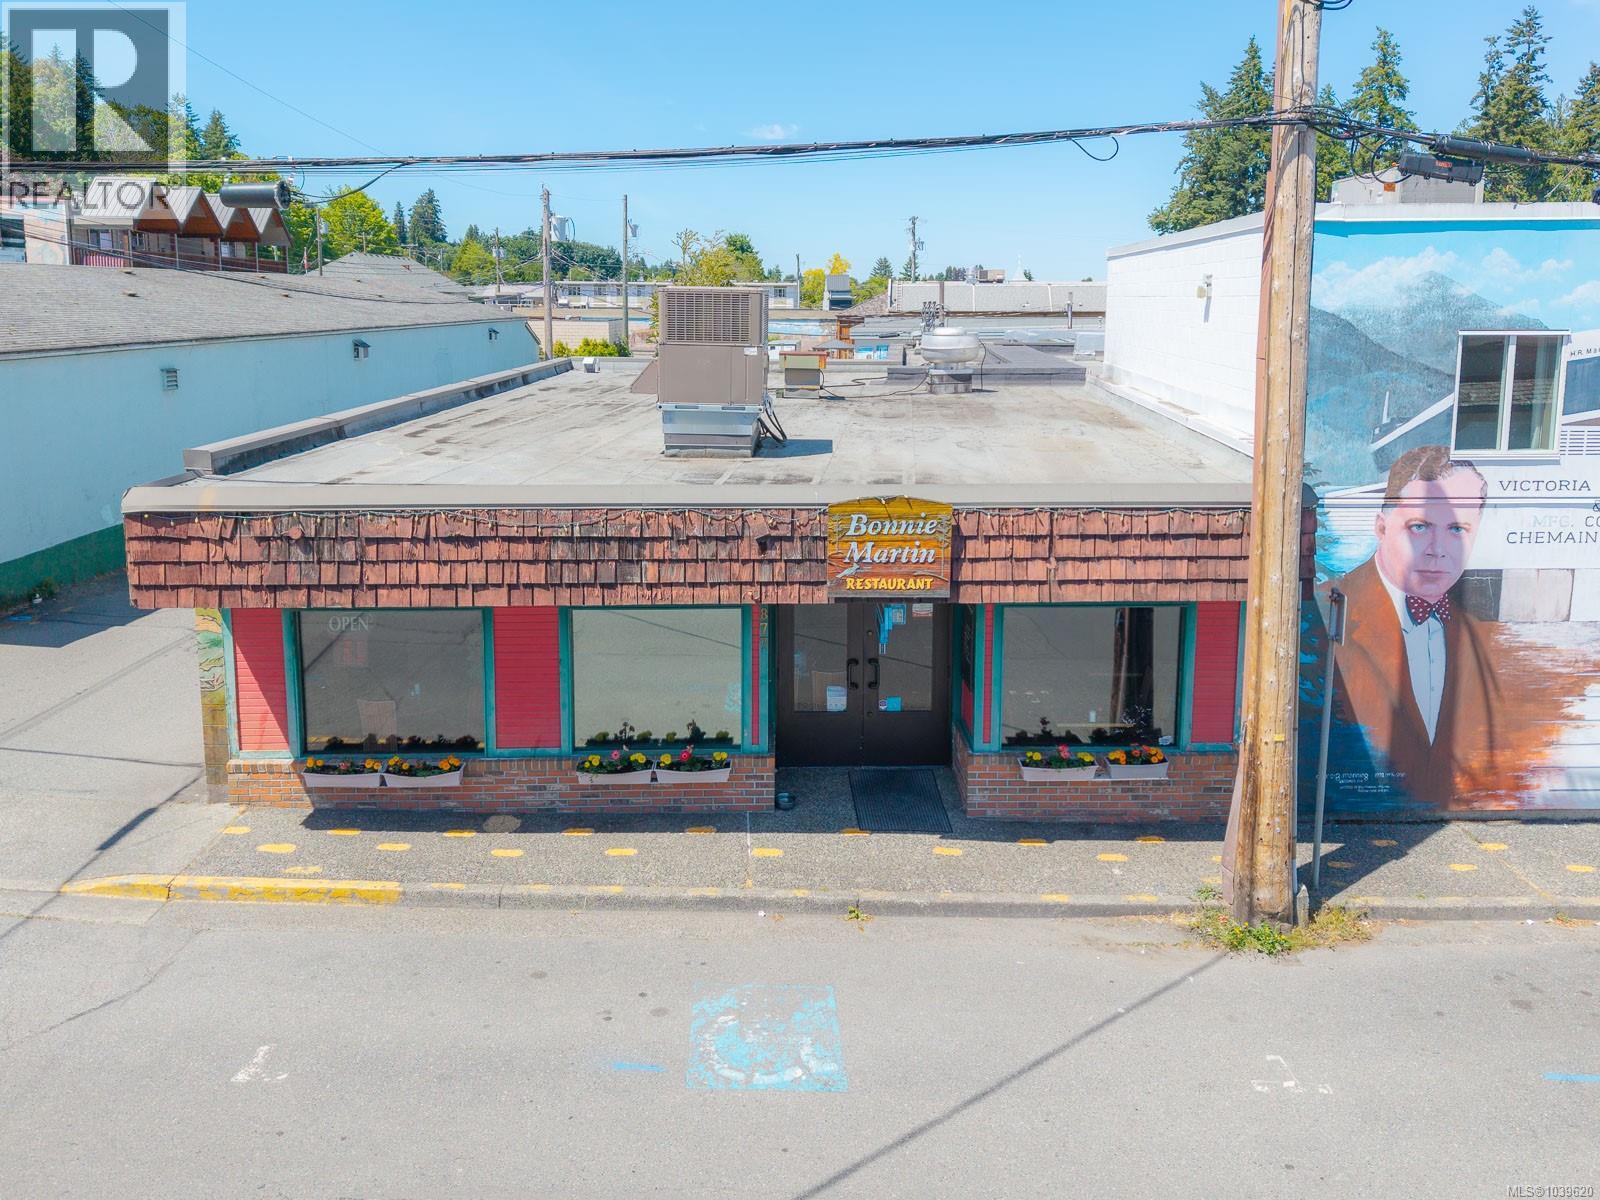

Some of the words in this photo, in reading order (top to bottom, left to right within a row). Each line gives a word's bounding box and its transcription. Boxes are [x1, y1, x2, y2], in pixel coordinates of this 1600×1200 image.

[1499, 479, 1591, 492] VICTORIA
[845, 512, 938, 537] Bonnie
[1506, 531, 1598, 544] CHEMAIN
[843, 540, 936, 564] Martin
[846, 577, 934, 590] RESTAURANT
[328, 615, 369, 632] OPEN
